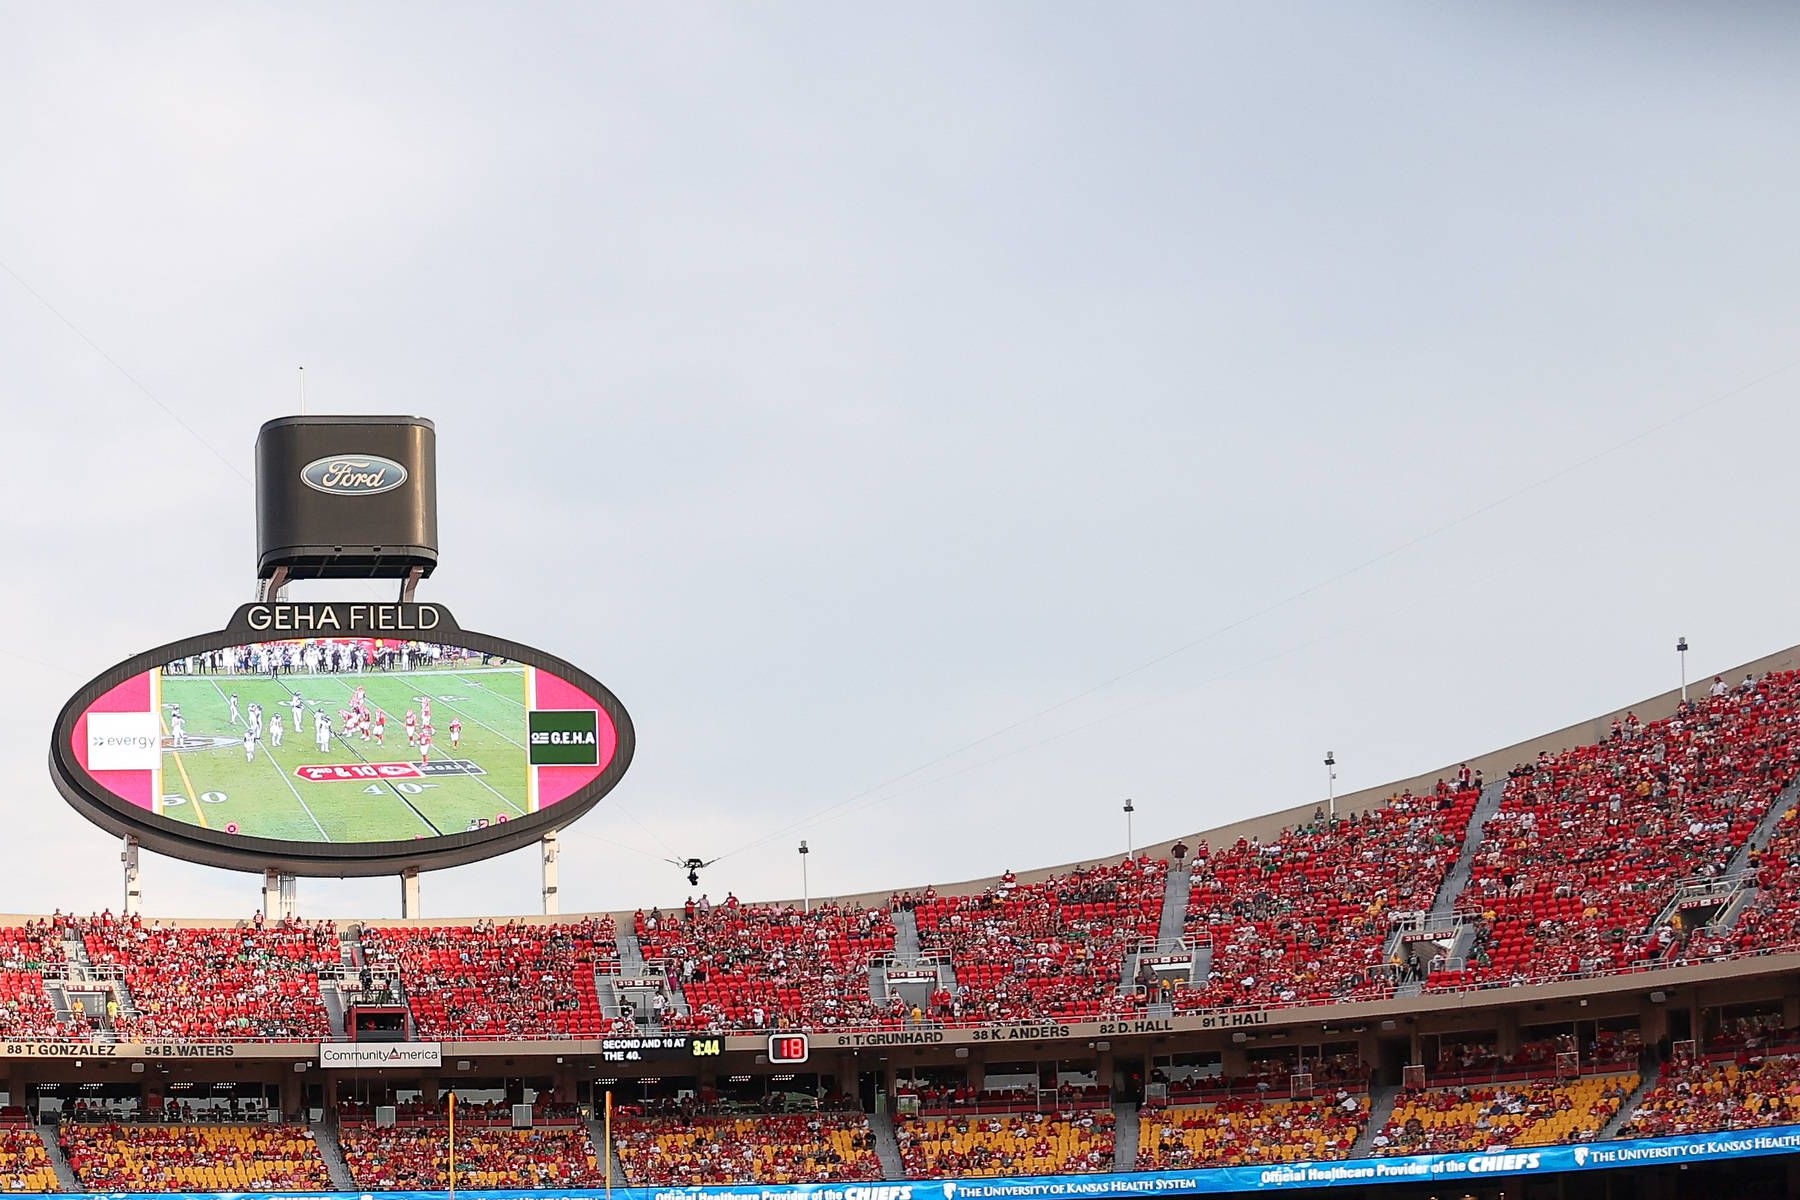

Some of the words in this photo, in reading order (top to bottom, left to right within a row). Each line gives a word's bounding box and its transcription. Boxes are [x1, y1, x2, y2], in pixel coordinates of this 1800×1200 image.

[322, 461, 386, 488] Ford
[248, 606, 340, 630] GEHA
[351, 606, 439, 630] FIELD
[107, 735, 156, 749] evergy
[334, 766, 350, 776] &
[353, 766, 373, 776] 10
[1100, 1024, 1115, 1034] 82
[1118, 1023, 1131, 1034] D.
[1135, 1020, 1172, 1032] HALL
[1202, 1018, 1215, 1027] 91
[1218, 1016, 1230, 1027] T.
[1233, 1013, 1268, 1025] HALI
[838, 1035, 850, 1045] 61
[853, 1034, 866, 1046] T.
[867, 1032, 943, 1045] GRUNHARD
[973, 1030, 988, 1041] 38
[991, 1029, 1006, 1041] K.
[1010, 1026, 1070, 1039] ANDERS
[7, 1045, 22, 1054] 88
[26, 1045, 36, 1055] T.
[38, 1045, 116, 1056] GONZALEZ
[145, 1047, 159, 1055] 54
[163, 1046, 175, 1056] B.
[177, 1045, 234, 1056] WATERS
[603, 1039, 639, 1050] SECOND
[641, 1039, 661, 1048] AND
[662, 1039, 672, 1048] 10
[673, 1038, 686, 1048] AT
[693, 1040, 719, 1056] 3:44
[781, 1039, 801, 1057] 18
[324, 1048, 438, 1062] CommunityAmerica
[603, 1051, 624, 1061] THE
[626, 1051, 641, 1061] 40.
[1261, 1170, 1305, 1184] Official
[1308, 1166, 1374, 1180] Healthcare
[1377, 1162, 1428, 1176] Provider
[1431, 1161, 1444, 1173] of
[1446, 1160, 1465, 1172] the
[1468, 1154, 1540, 1173] CHIEFS
[959, 1187, 981, 1197] THE
[984, 1184, 1049, 1196] UNIVERSITY
[1050, 1184, 1064, 1194] OF
[1067, 1181, 1109, 1193] KANSAS
[1111, 1180, 1154, 1191] HEALTH
[1155, 1179, 1196, 1190] SYSTEM
